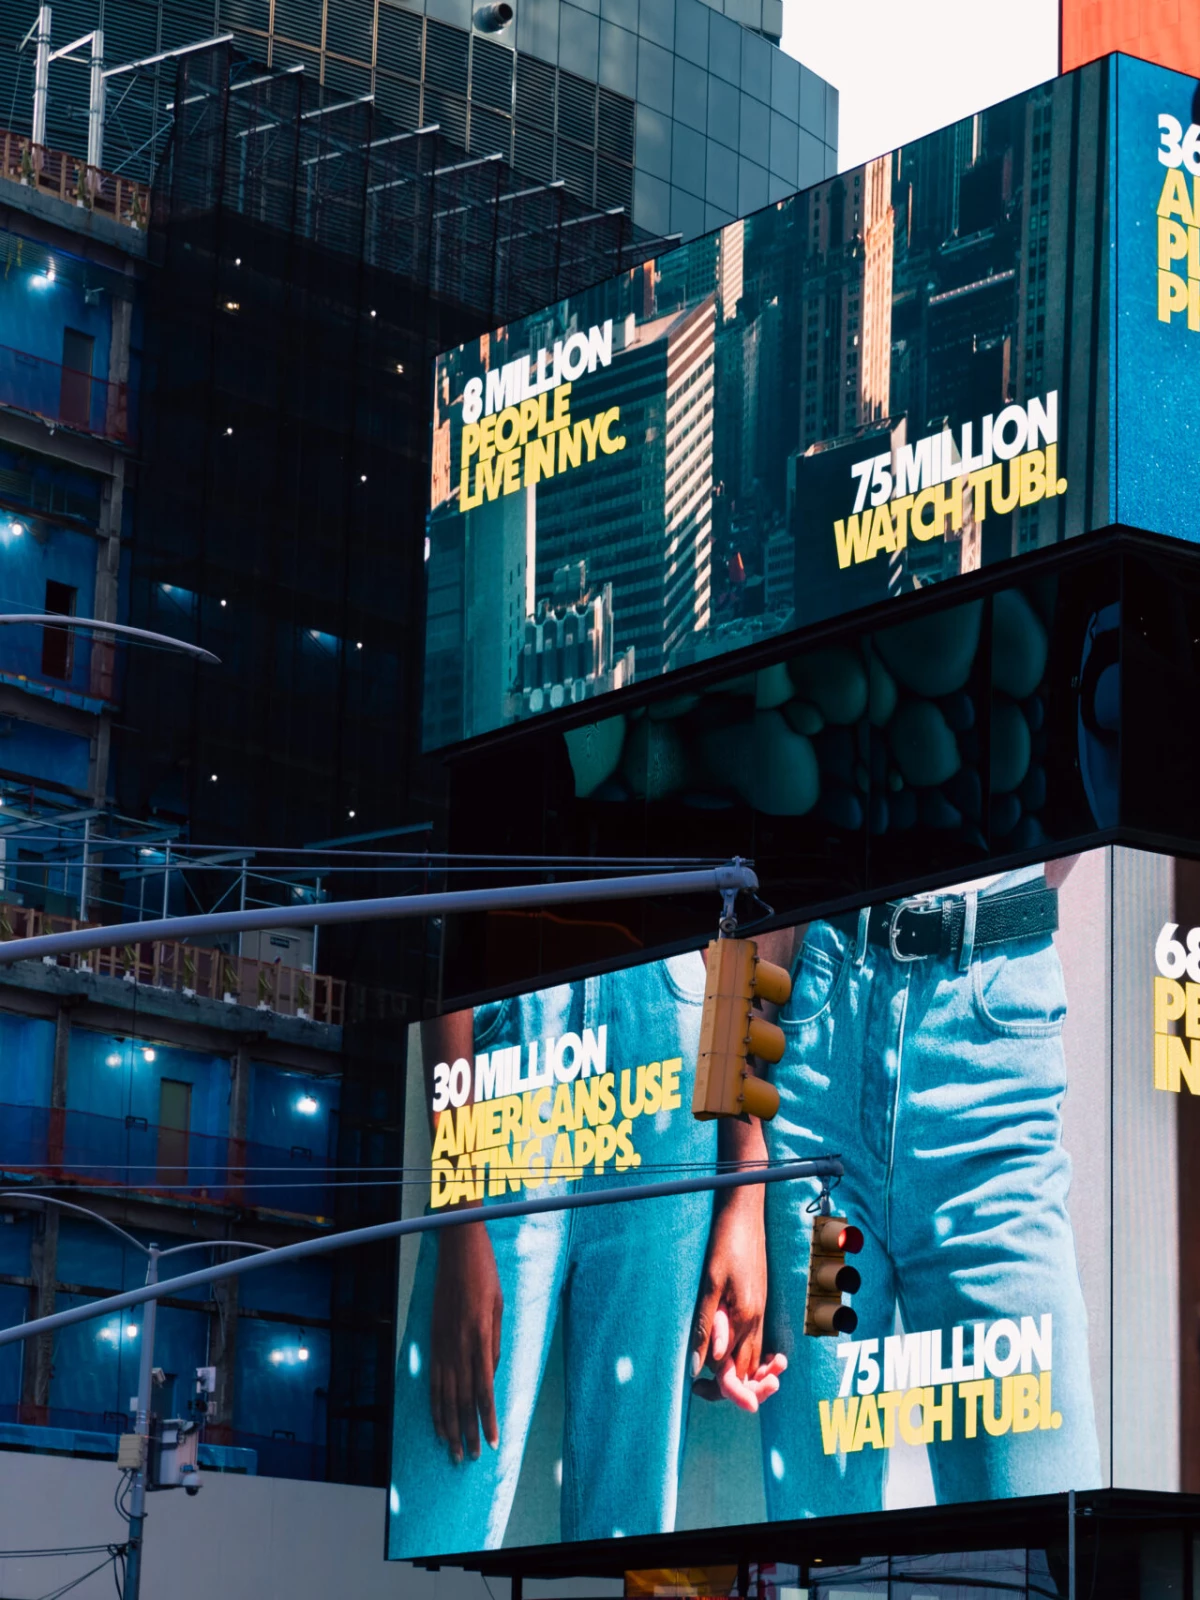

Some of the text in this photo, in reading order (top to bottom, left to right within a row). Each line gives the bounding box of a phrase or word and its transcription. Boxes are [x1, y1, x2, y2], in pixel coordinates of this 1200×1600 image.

[462, 319, 613, 424] 8 MILLION
[459, 406, 626, 512] LIVE IN NYC.
[461, 382, 572, 469] PEOPLE
[851, 390, 1058, 514] 75 MILLION
[834, 443, 1067, 569] WATCH TUBI.
[431, 1057, 682, 1160] AMERICANS USE
[432, 1025, 607, 1112] 30 MILLION
[430, 1119, 641, 1209] DATING APPS.
[836, 1313, 1052, 1398] 75 MILLION
[818, 1370, 1062, 1455] WATCH TUBI.
